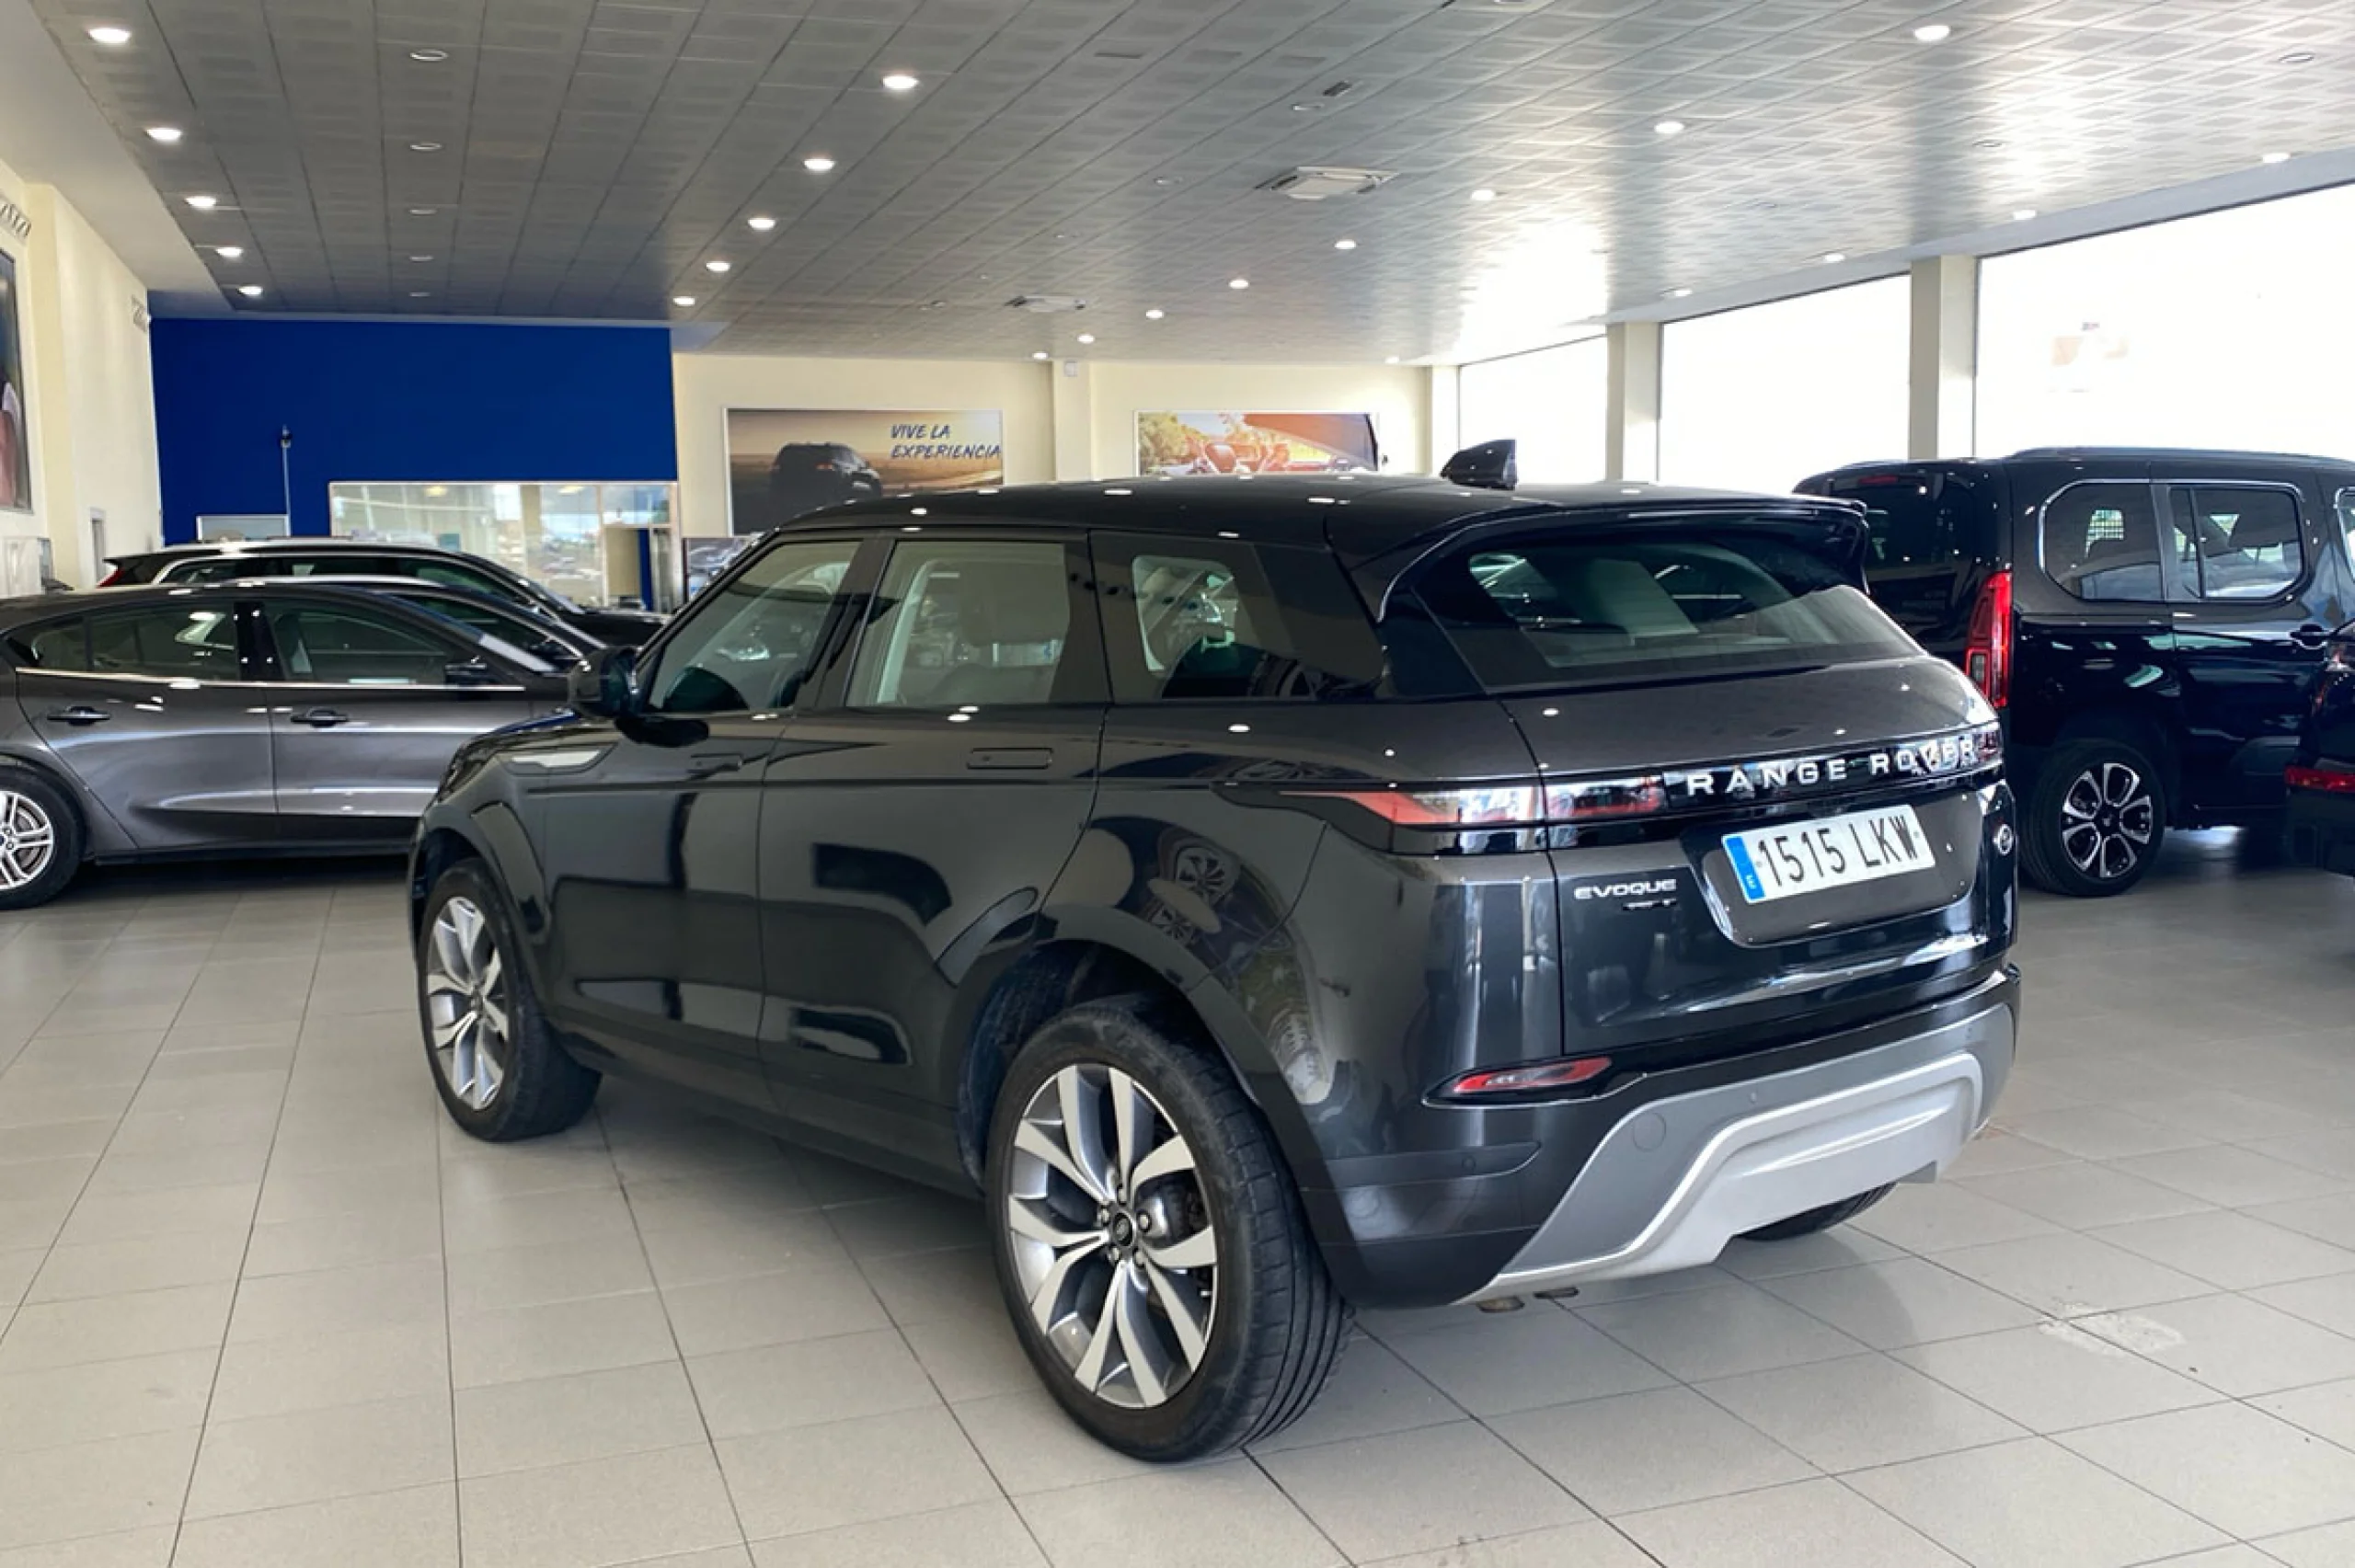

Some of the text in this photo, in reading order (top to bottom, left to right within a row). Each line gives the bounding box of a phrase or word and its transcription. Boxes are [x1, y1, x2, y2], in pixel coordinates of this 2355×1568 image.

[890, 423, 951, 439] VIVE LA
[890, 443, 1001, 459] EXPERIENCIA
[1686, 736, 1978, 796] RANGE ROVER
[1757, 828, 1846, 887] 1515
[1848, 814, 1919, 869] LKW
[1573, 878, 1677, 899] EVOQUE
